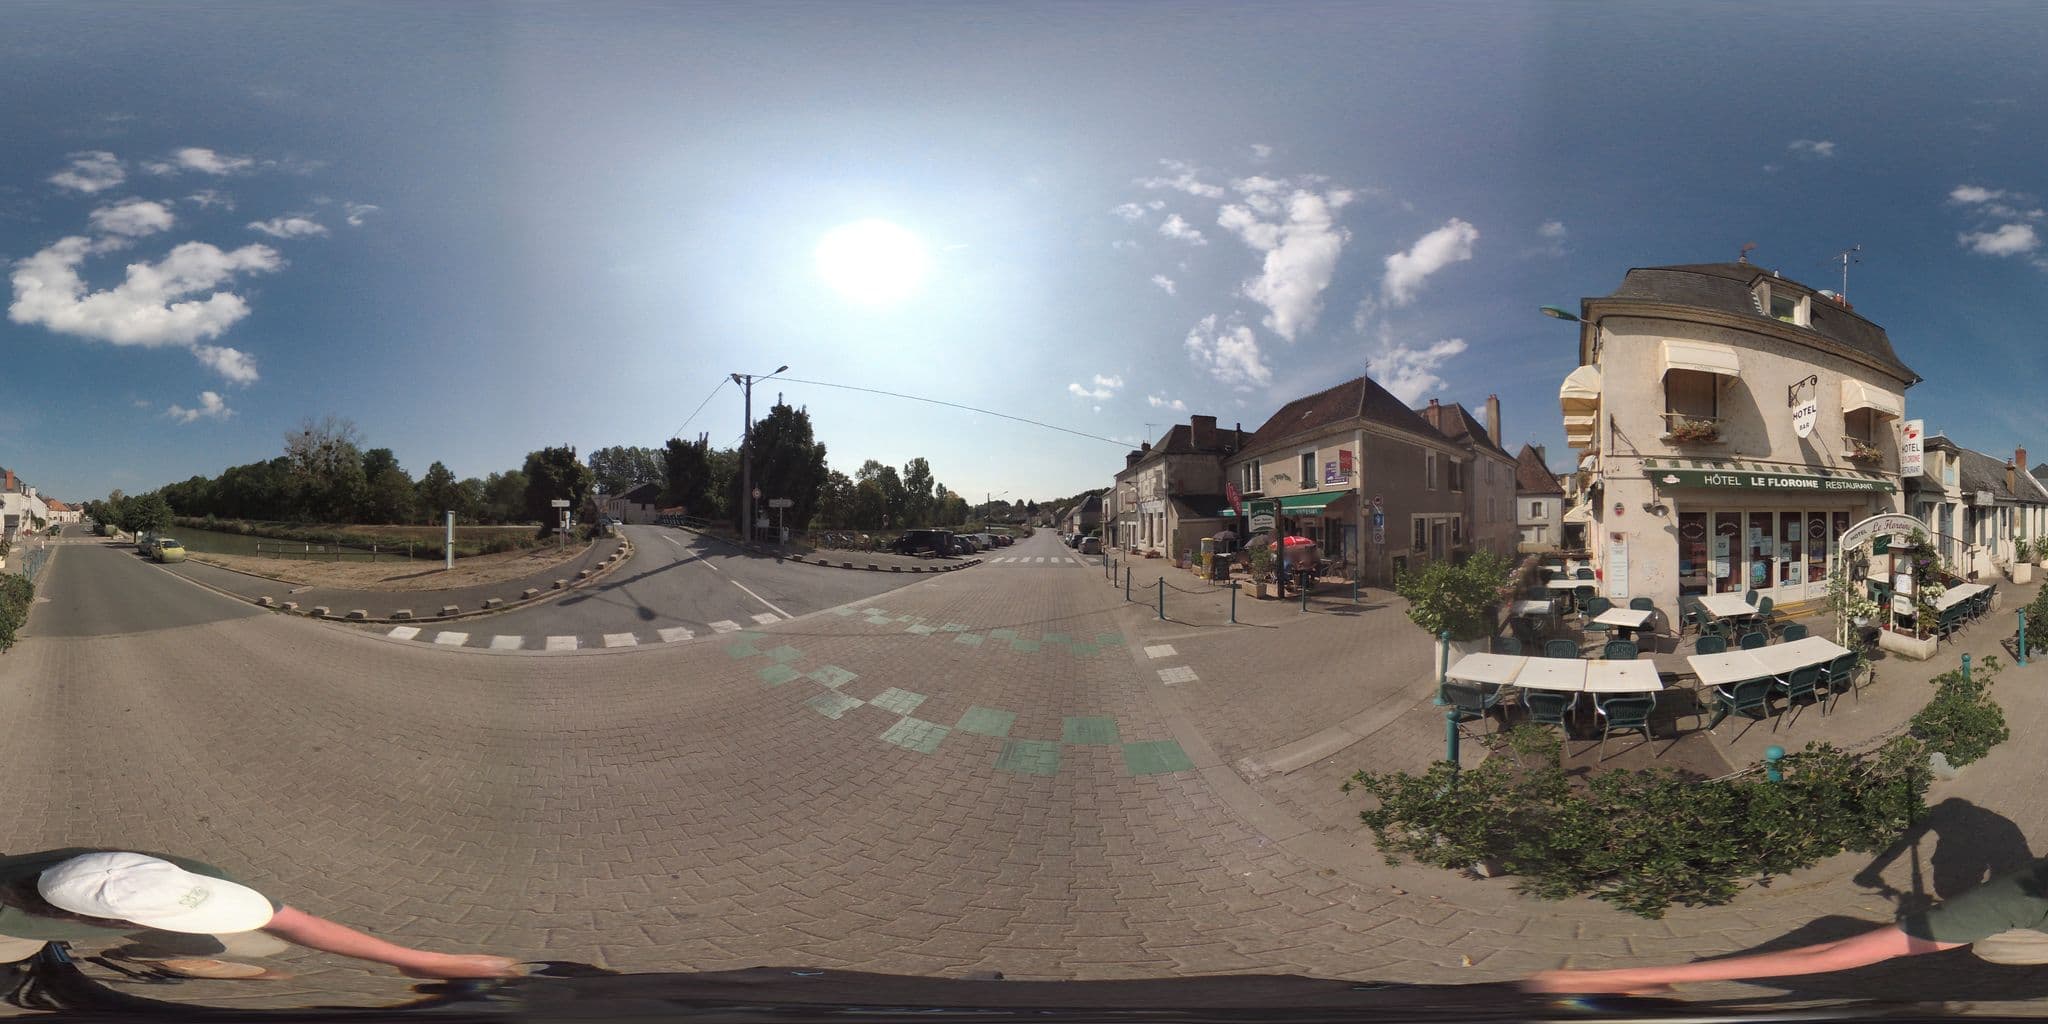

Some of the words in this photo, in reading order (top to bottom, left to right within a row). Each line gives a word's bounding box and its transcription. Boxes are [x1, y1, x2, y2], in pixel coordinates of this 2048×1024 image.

[1793, 405, 1817, 420] HOTEL
[1800, 422, 1810, 431] BAR
[1704, 473, 1742, 487] HÔTEL
[1751, 476, 1766, 487] LE
[1767, 478, 1819, 489] FLOROINE
[1825, 481, 1874, 490] RESTAURANT
[1850, 528, 1868, 541] HOTEL
[1872, 521, 1882, 533] Le
